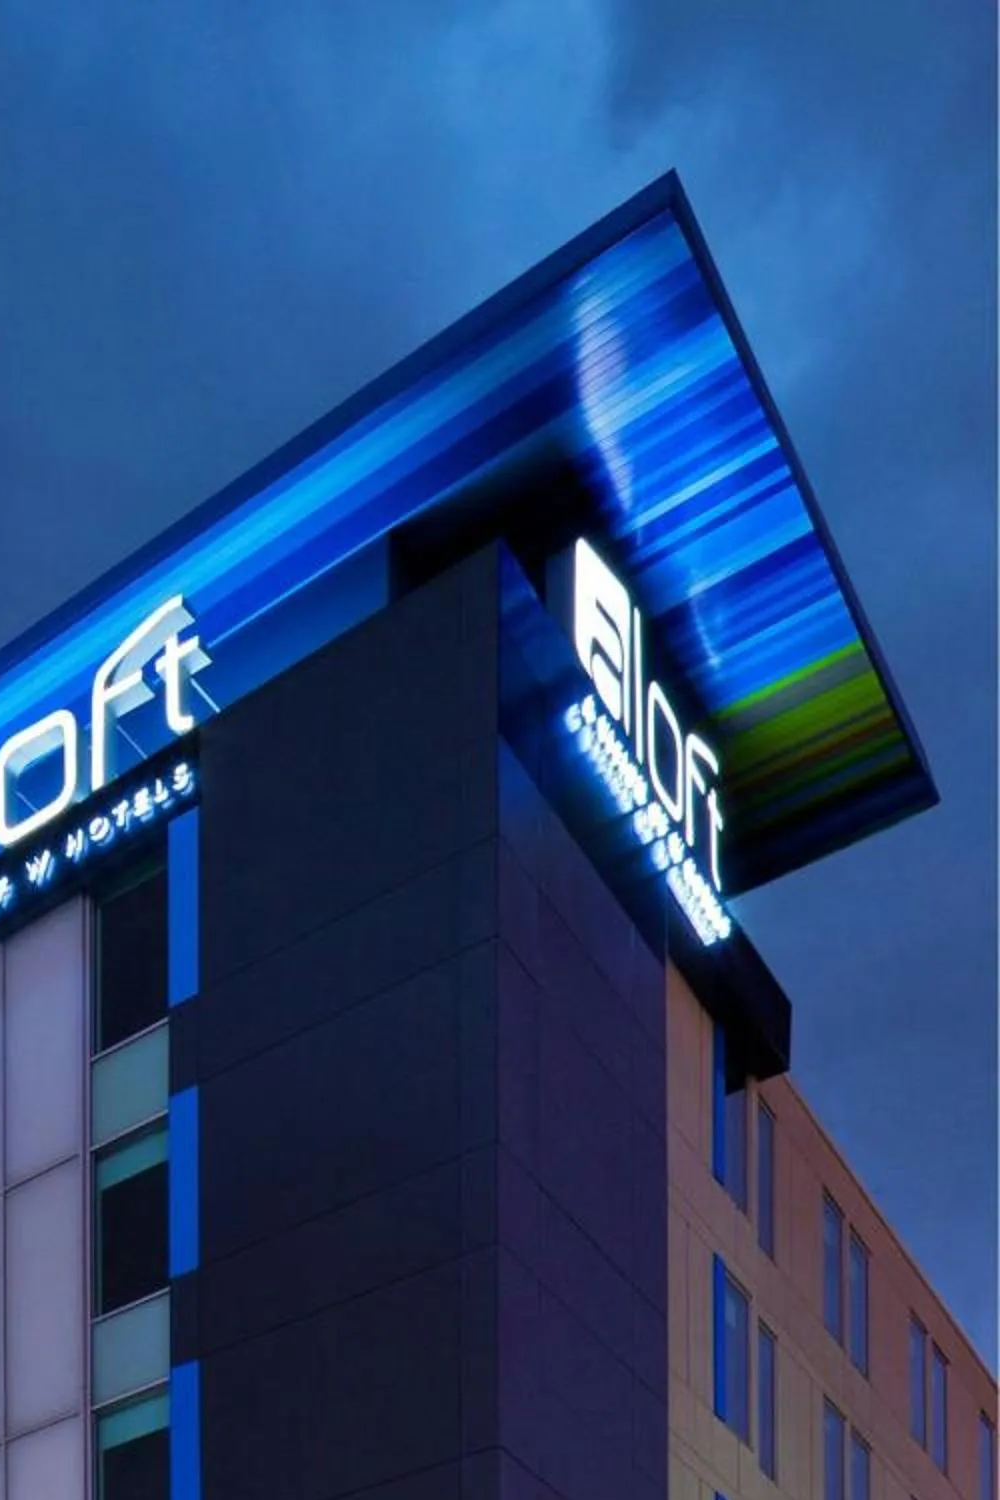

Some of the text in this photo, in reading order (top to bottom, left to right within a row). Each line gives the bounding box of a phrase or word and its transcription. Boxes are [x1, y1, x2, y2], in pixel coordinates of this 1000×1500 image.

[25, 850, 53, 884] W
[64, 762, 194, 861] HOTELS
[575, 537, 723, 892] aloft
